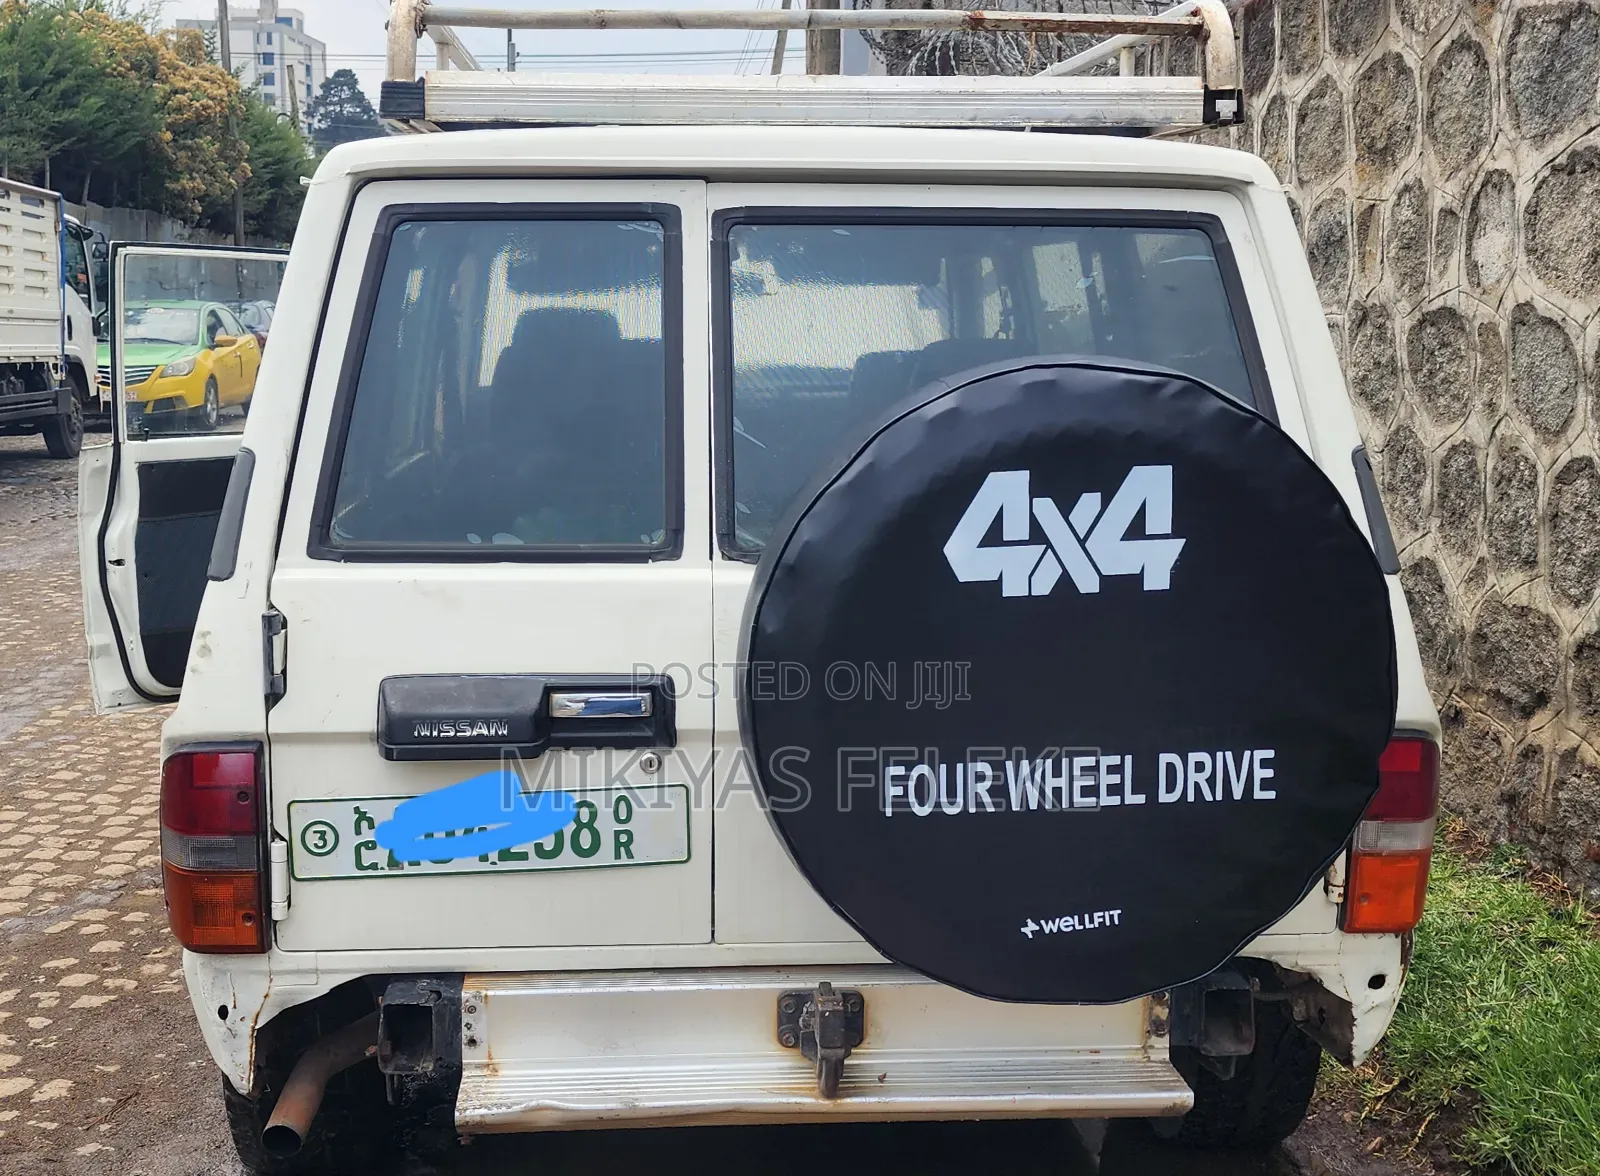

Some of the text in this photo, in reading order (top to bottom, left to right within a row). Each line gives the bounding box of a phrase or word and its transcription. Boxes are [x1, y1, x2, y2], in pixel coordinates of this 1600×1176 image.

[413, 719, 509, 738] NISSAN
[885, 748, 1277, 818] FOUR WHEEL DRIVE
